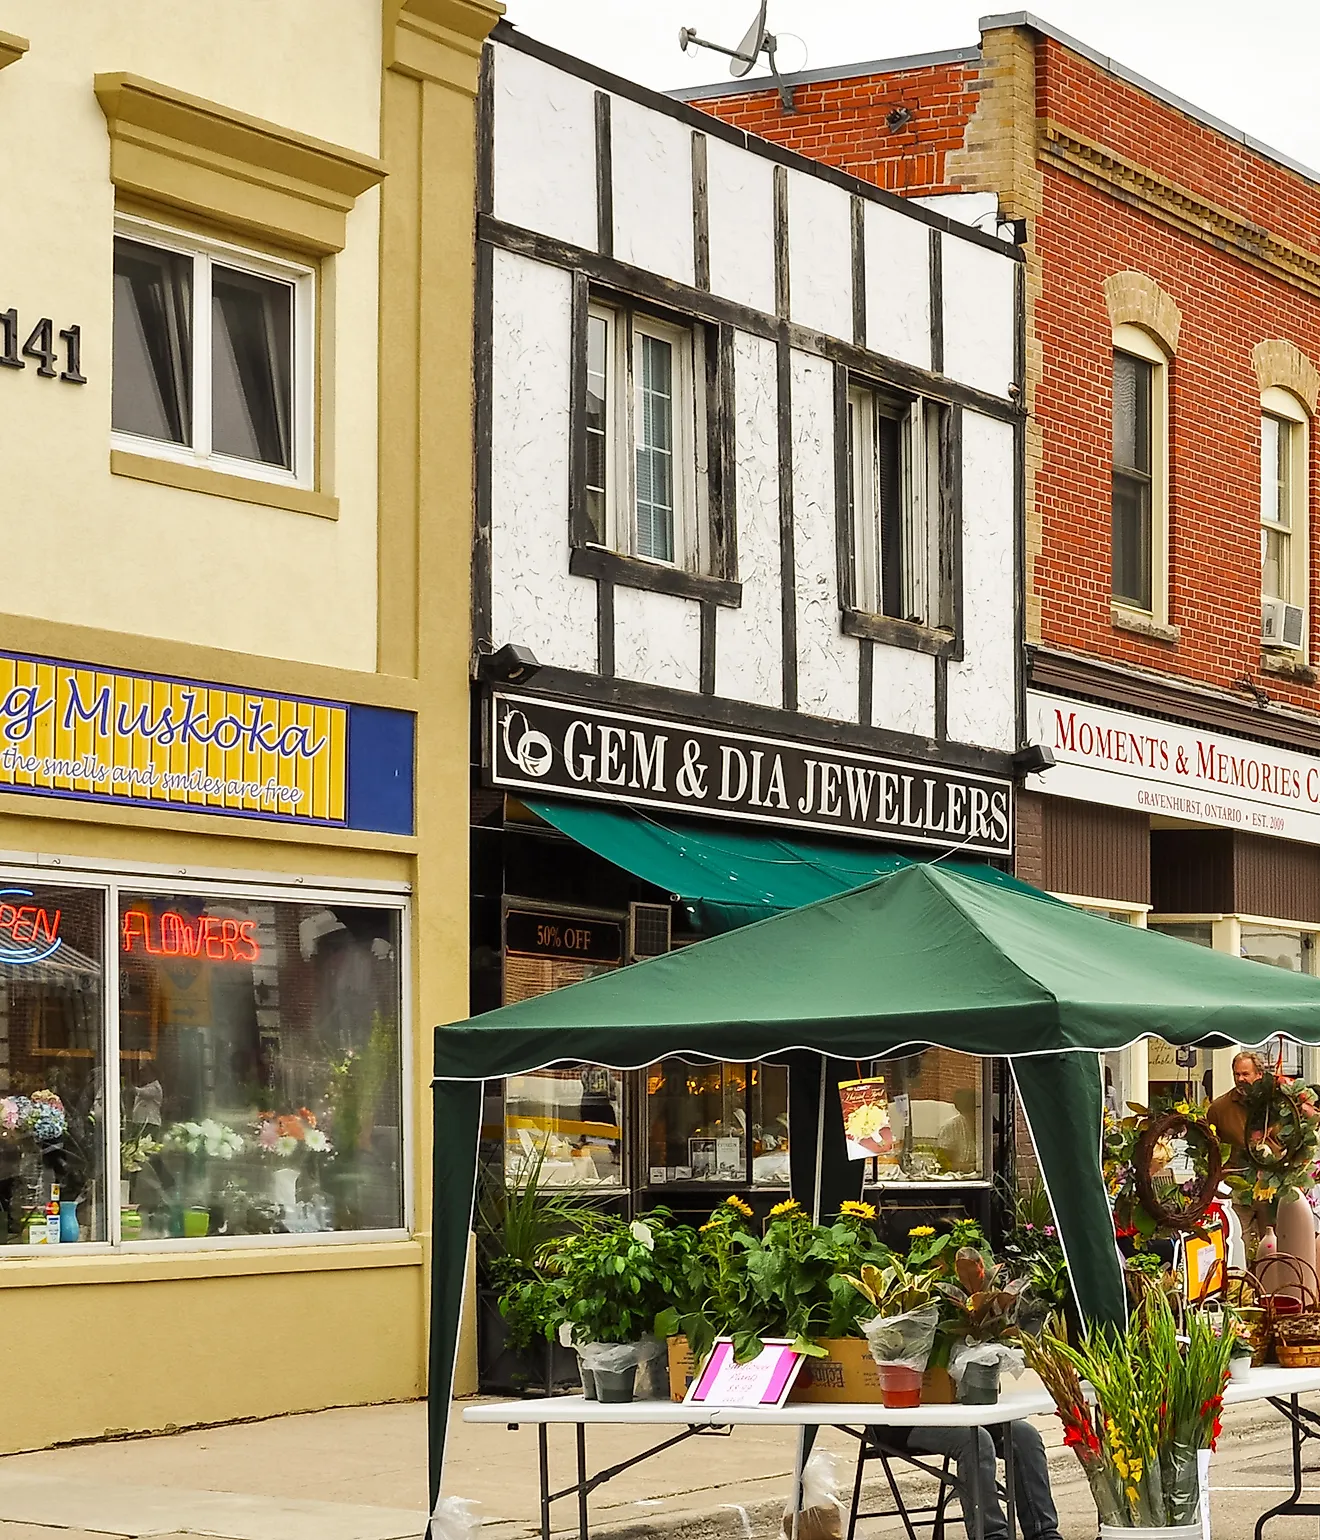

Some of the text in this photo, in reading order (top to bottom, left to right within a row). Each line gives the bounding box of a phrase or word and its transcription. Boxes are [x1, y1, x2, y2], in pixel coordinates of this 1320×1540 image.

[0, 308, 87, 384] 141
[0, 678, 328, 758] g Muskoka
[2, 748, 303, 803] the smells and smiles are free
[563, 719, 1008, 844] GEM & DIA JEWELLERS
[1054, 709, 1168, 771] MOMENTS
[1175, 745, 1190, 775] &
[1196, 740, 1301, 799] MEMORIES
[1138, 790, 1203, 818] GRAVENHURST,
[1205, 803, 1241, 823] ONTARIO
[1270, 816, 1285, 831] 2009
[122, 910, 260, 962] FLOWERS
[537, 925, 592, 950] 50% OFF
